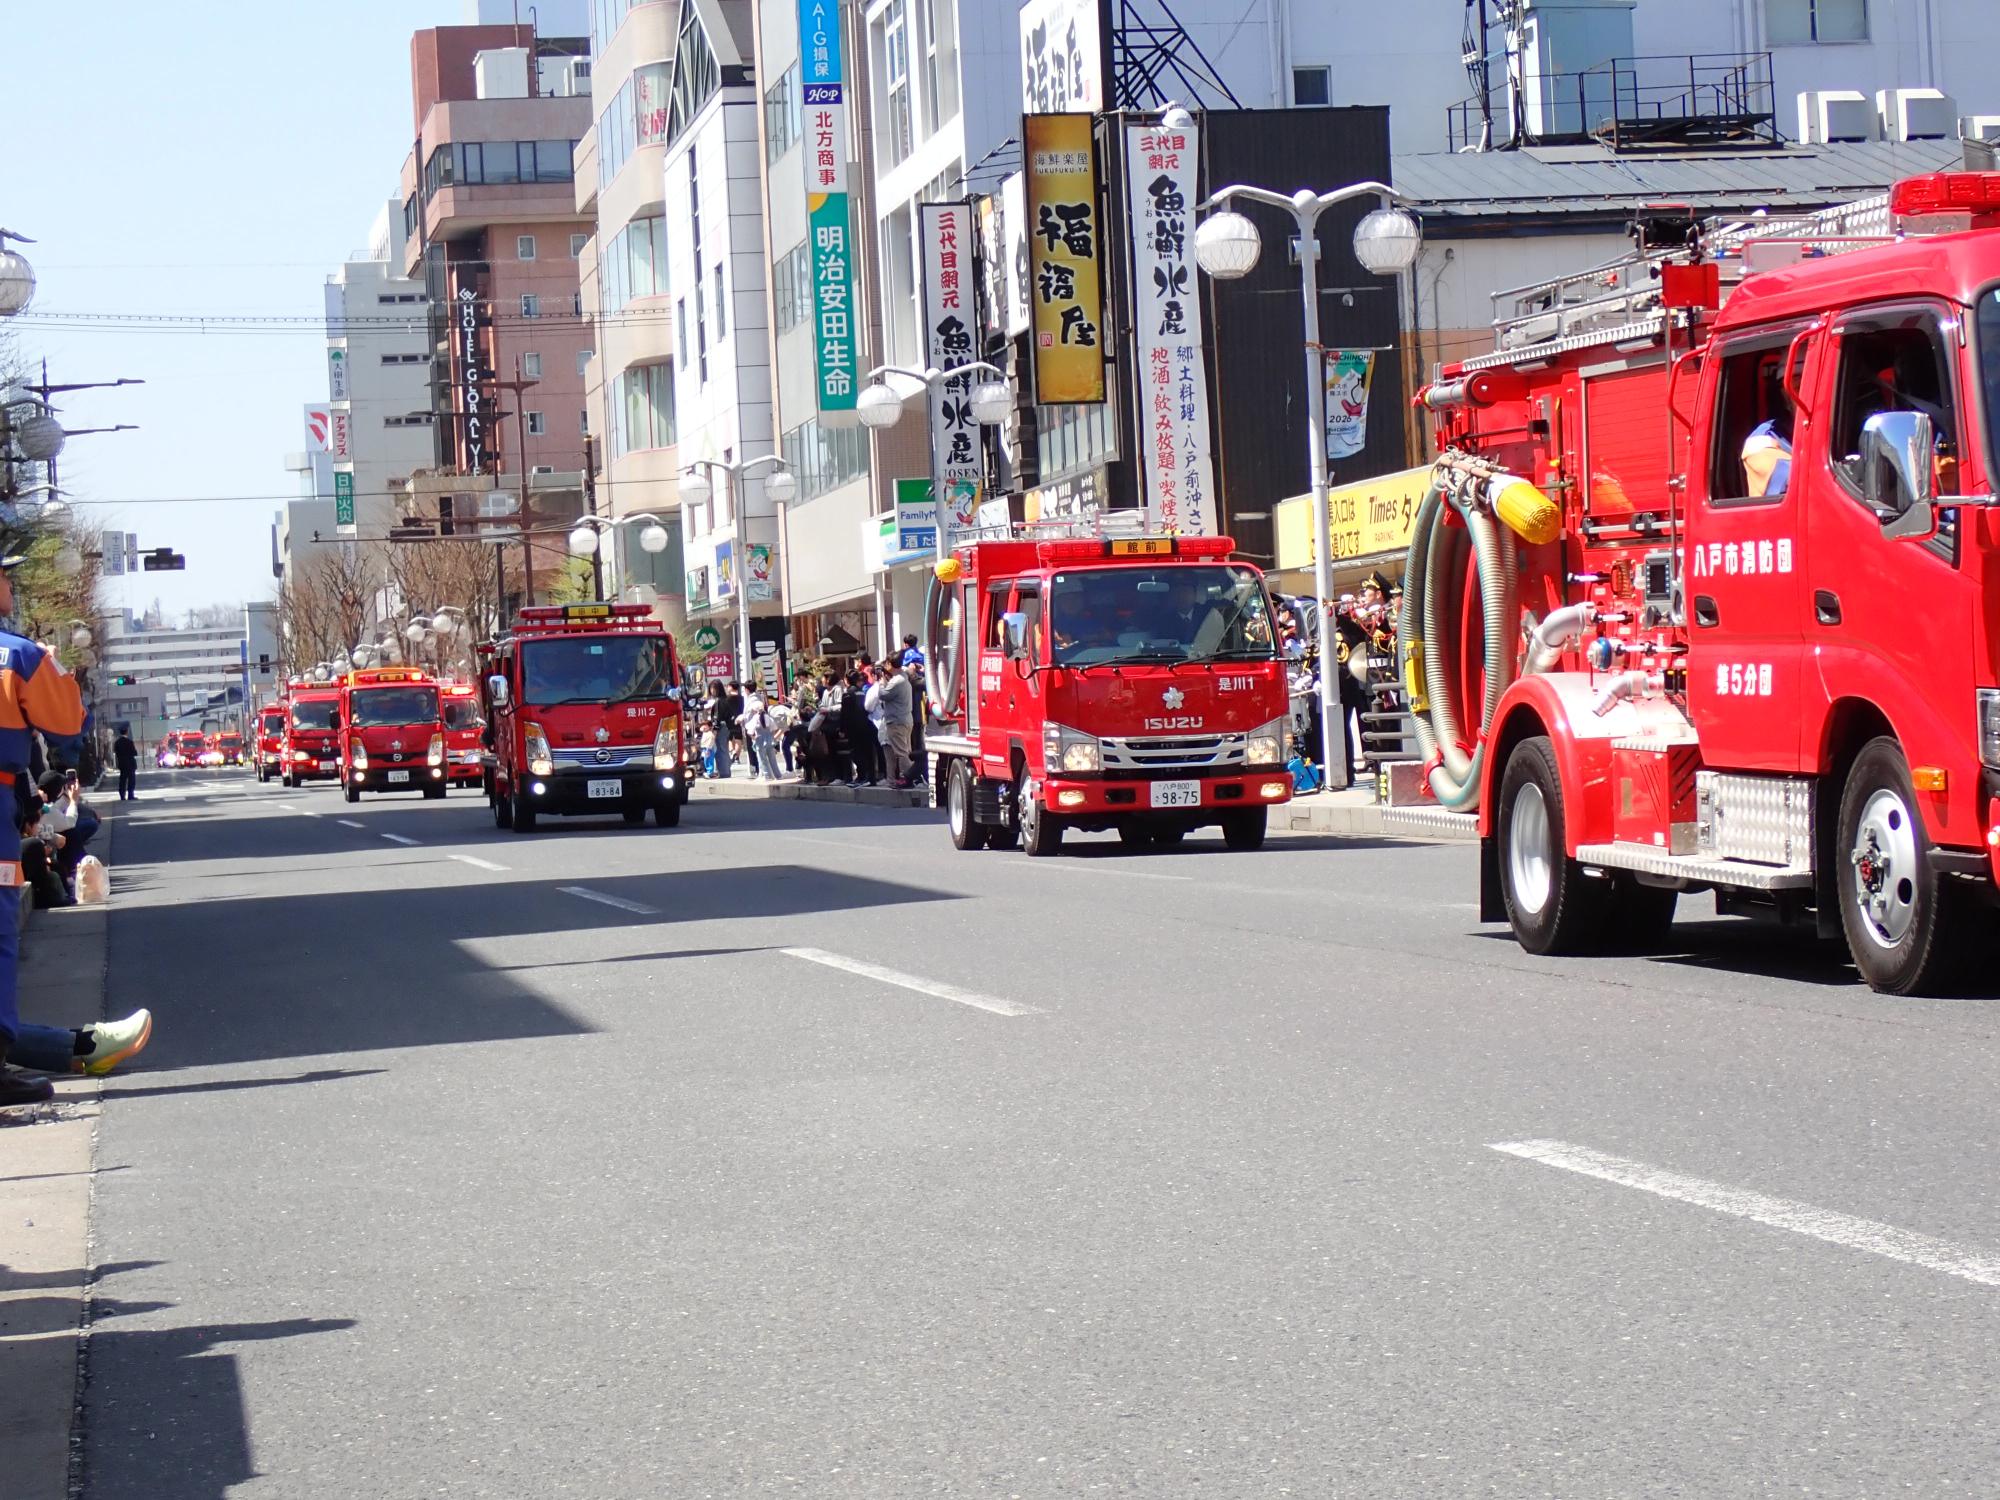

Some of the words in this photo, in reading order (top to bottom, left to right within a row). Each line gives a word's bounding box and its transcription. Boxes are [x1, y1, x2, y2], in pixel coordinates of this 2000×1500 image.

[812, 3, 830, 76] AIG損保
[809, 87, 838, 102] HOP
[815, 111, 836, 186] 北方商事
[1140, 135, 1186, 152] 三代目
[1034, 152, 1089, 166] 海鮮楽屋
[1148, 153, 1180, 170] 網元
[937, 211, 960, 310] 三代目網元
[1148, 174, 1191, 337] 魚鮮水産
[1036, 202, 1096, 348] 福福屋
[816, 225, 851, 397] 明治安田生命
[463, 305, 476, 363] HOTEL
[1329, 415, 1352, 423] 2026
[1369, 494, 1398, 525] Times
[905, 535, 919, 548] 酒
[1218, 677, 1255, 691] 是川1
[1716, 663, 1773, 696] 第5分団
[627, 707, 657, 717] 是川2
[1144, 716, 1203, 730] ISUZU
[1162, 791, 1198, 805] 98-75
